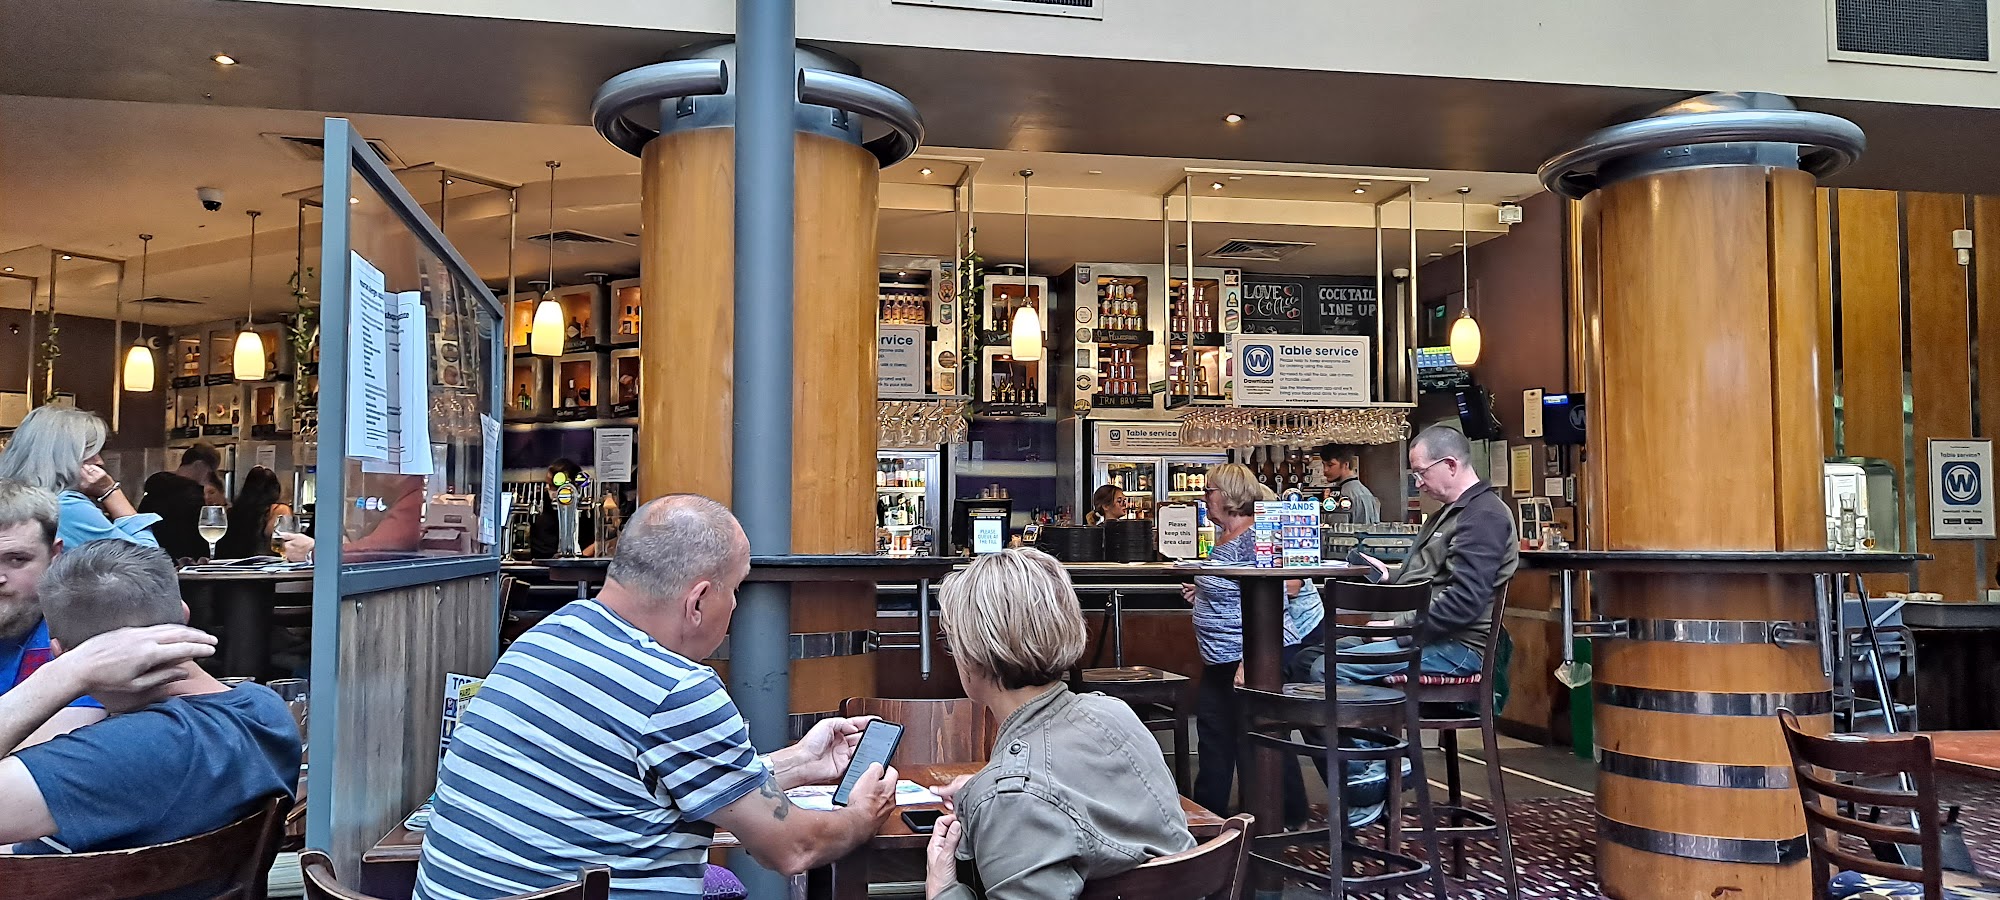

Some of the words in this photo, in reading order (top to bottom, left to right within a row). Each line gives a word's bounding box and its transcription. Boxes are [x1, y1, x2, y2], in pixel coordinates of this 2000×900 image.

[1243, 284, 1282, 300] LOVE
[1319, 288, 1376, 301] COCKTAIL
[1320, 303, 1353, 316] LINE
[1358, 304, 1376, 317] UP
[879, 334, 914, 346] rvice
[1279, 345, 1312, 356] Table
[1315, 345, 1359, 357] service
[1126, 429, 1148, 437] Table
[1148, 429, 1178, 437] service
